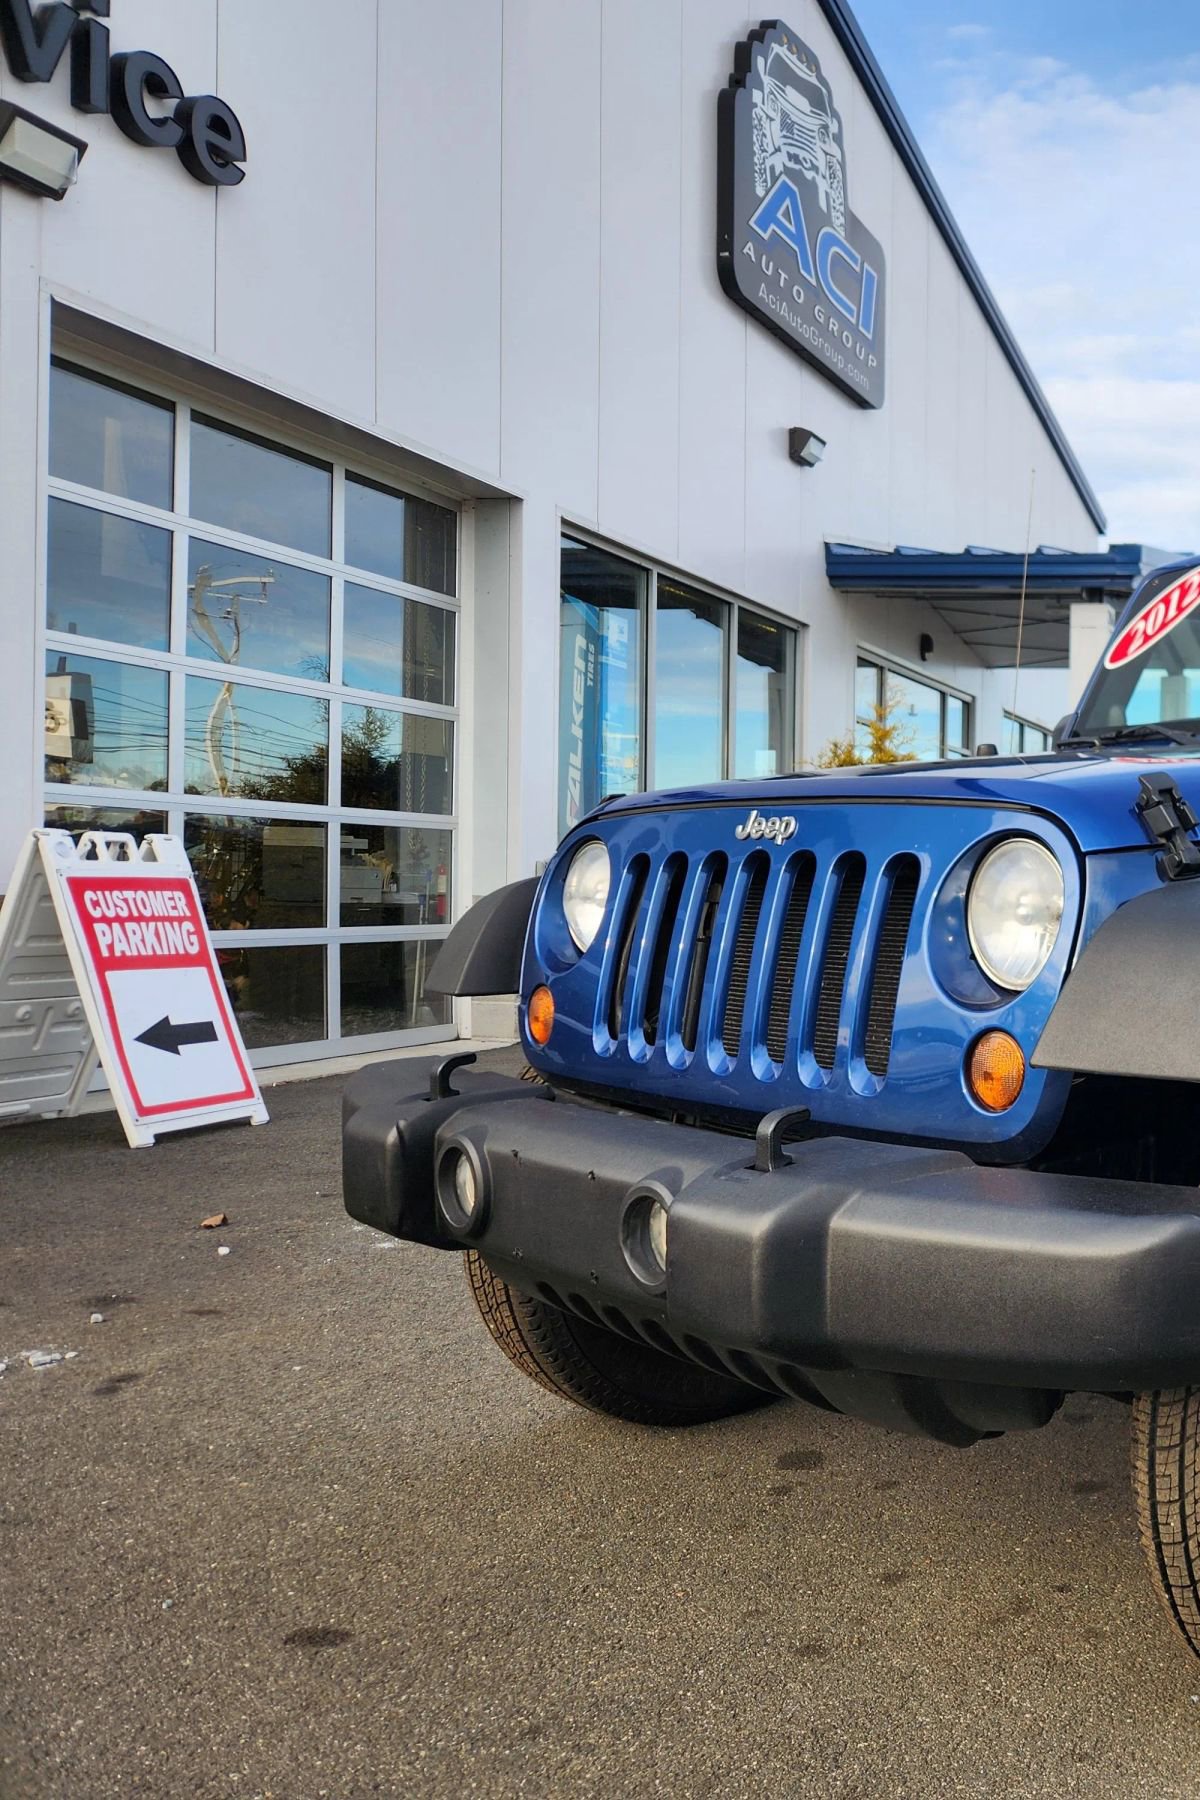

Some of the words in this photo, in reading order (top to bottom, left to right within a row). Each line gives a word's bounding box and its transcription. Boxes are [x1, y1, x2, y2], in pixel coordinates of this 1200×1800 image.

[748, 174, 877, 340] ACI
[742, 240, 805, 304] AUTO
[813, 304, 878, 368] GROUP
[757, 281, 871, 391] AciAutoGroup.com
[586, 642, 596, 688] TIRES
[735, 809, 798, 846] Jeep
[84, 890, 191, 919] CUSTOMER
[93, 920, 200, 958] PARKING
